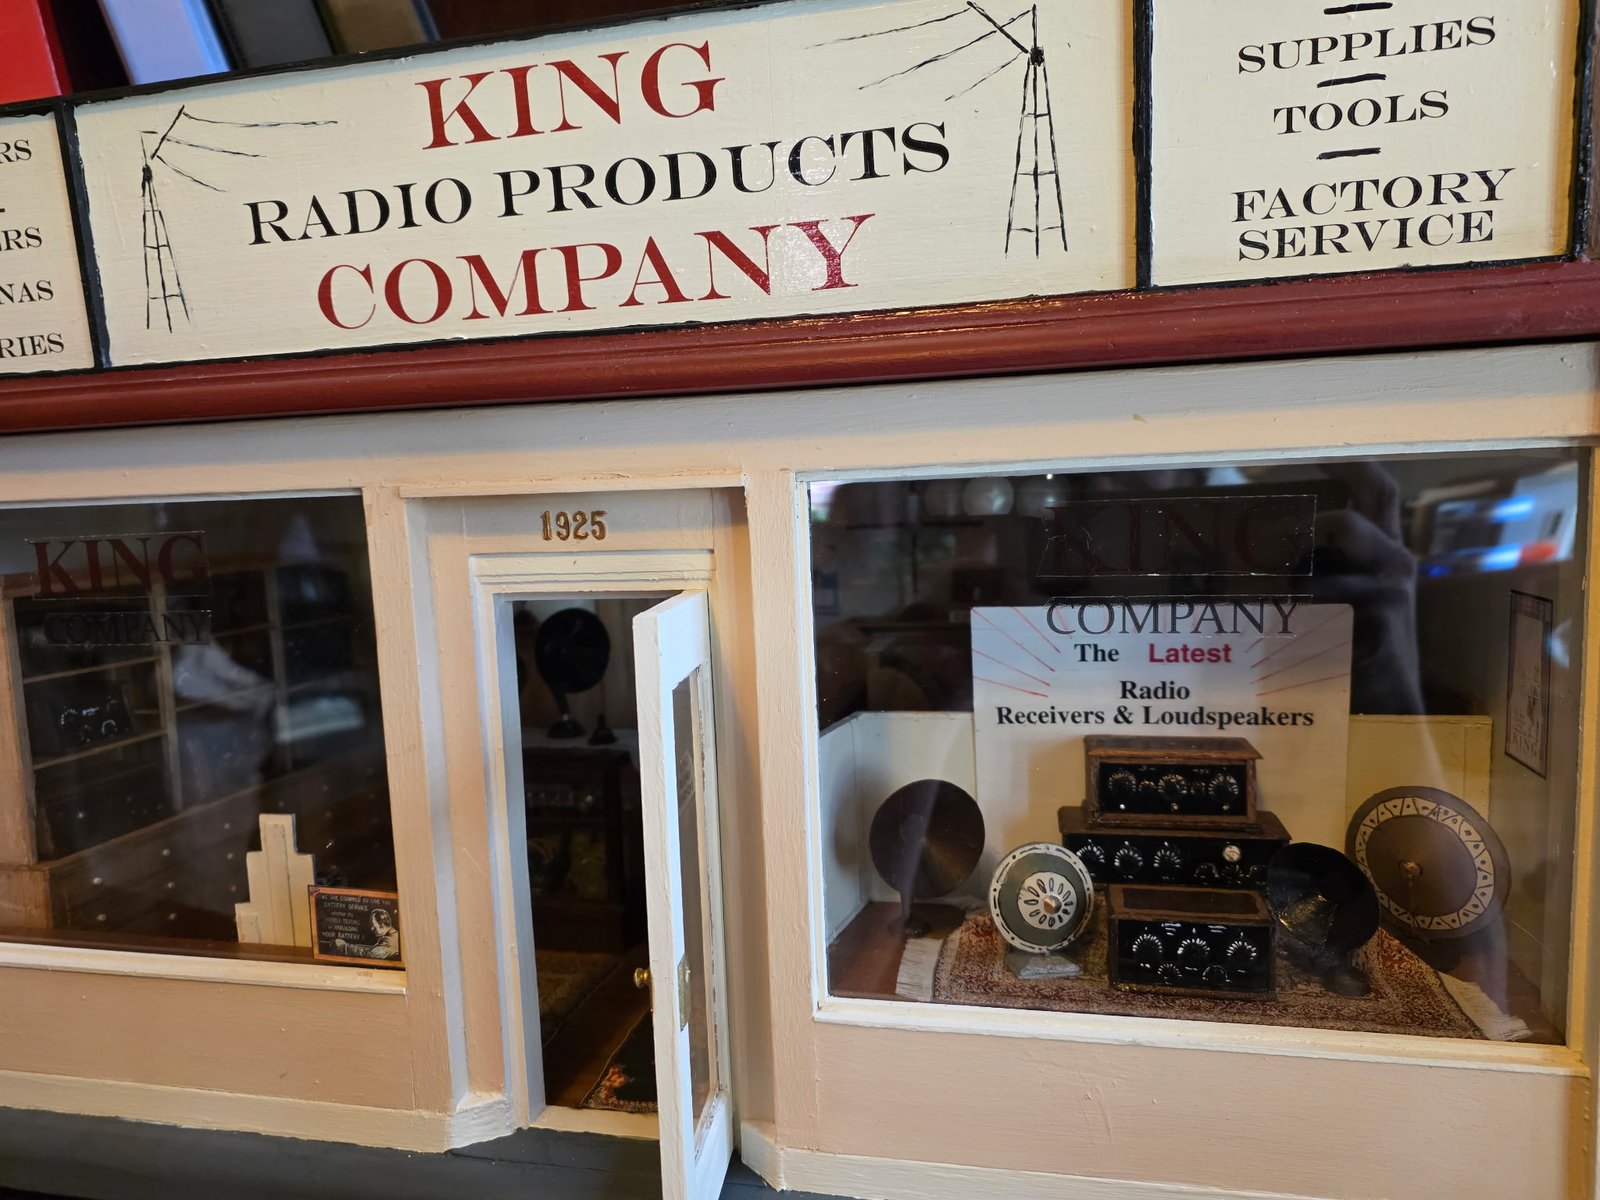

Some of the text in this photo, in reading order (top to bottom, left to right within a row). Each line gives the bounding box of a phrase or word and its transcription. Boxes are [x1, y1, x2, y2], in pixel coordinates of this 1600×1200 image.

[1238, 16, 1496, 74] SUPPLIES
[415, 40, 725, 150] KING
[1273, 90, 1450, 135] TOOLS
[243, 121, 950, 246] RADIO PRODUCTS
[1232, 167, 1515, 223] FACTORY
[0, 226, 43, 251] RS
[1237, 209, 1495, 262] SERVICE
[317, 213, 876, 330] COMPANY
[540, 510, 608, 541] 1925
[1042, 501, 1312, 572] KING
[29, 533, 209, 597] KING
[44, 613, 211, 644] COMPANY
[1046, 599, 1298, 636] COMPANY
[1074, 643, 1232, 664] The Latest
[1120, 680, 1190, 700] Radio
[996, 706, 1314, 731] Receivers & Loudspeakers
